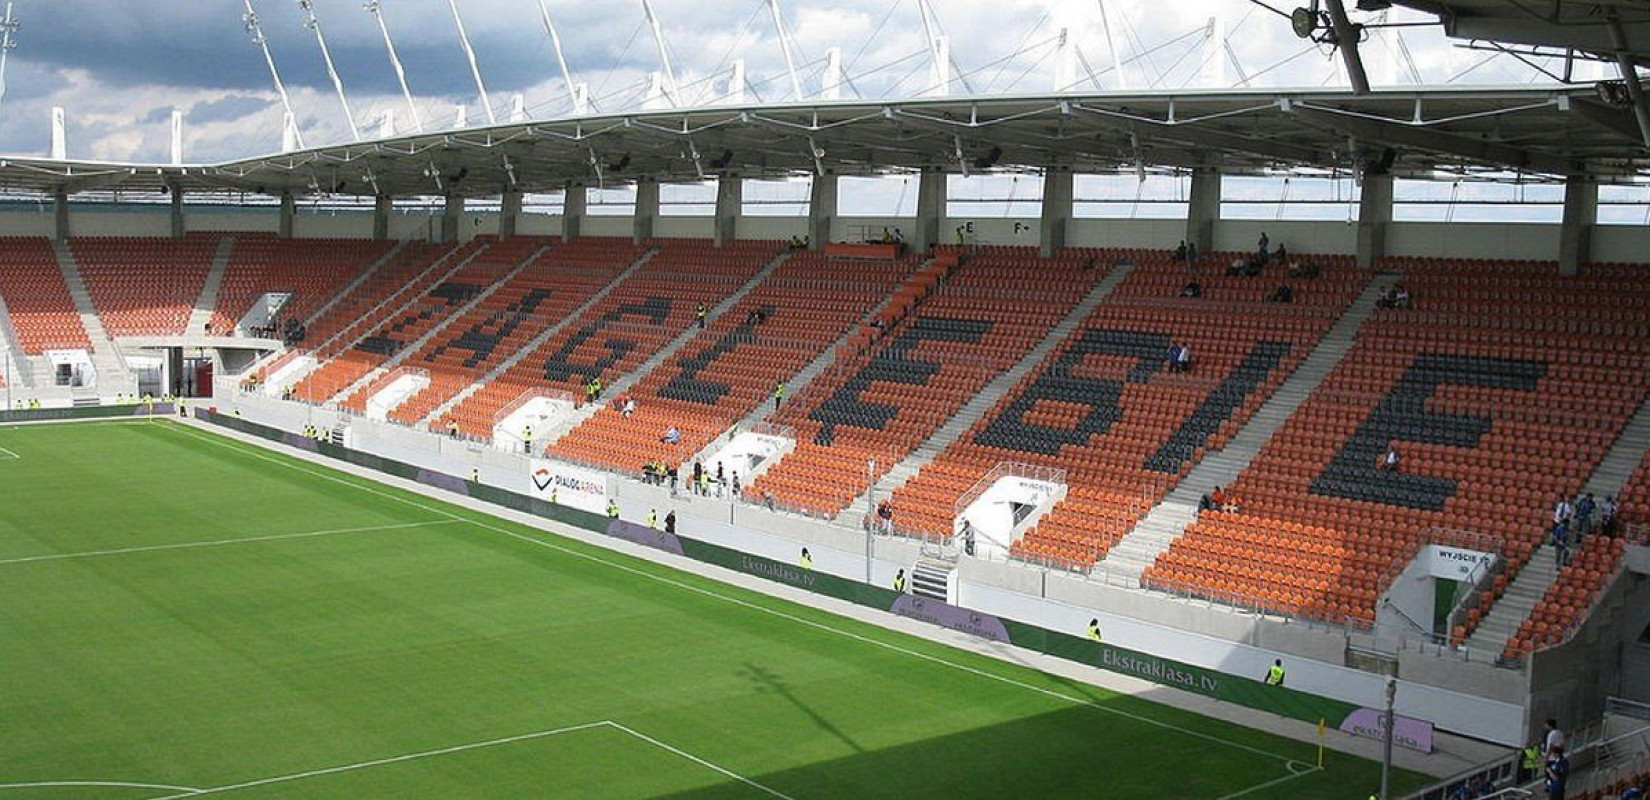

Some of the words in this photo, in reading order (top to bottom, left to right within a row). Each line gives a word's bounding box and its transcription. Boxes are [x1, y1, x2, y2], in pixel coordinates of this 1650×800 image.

[965, 222, 974, 233] E
[1013, 222, 1022, 234] F
[1102, 649, 1219, 691] Ekstraklasa.tv
